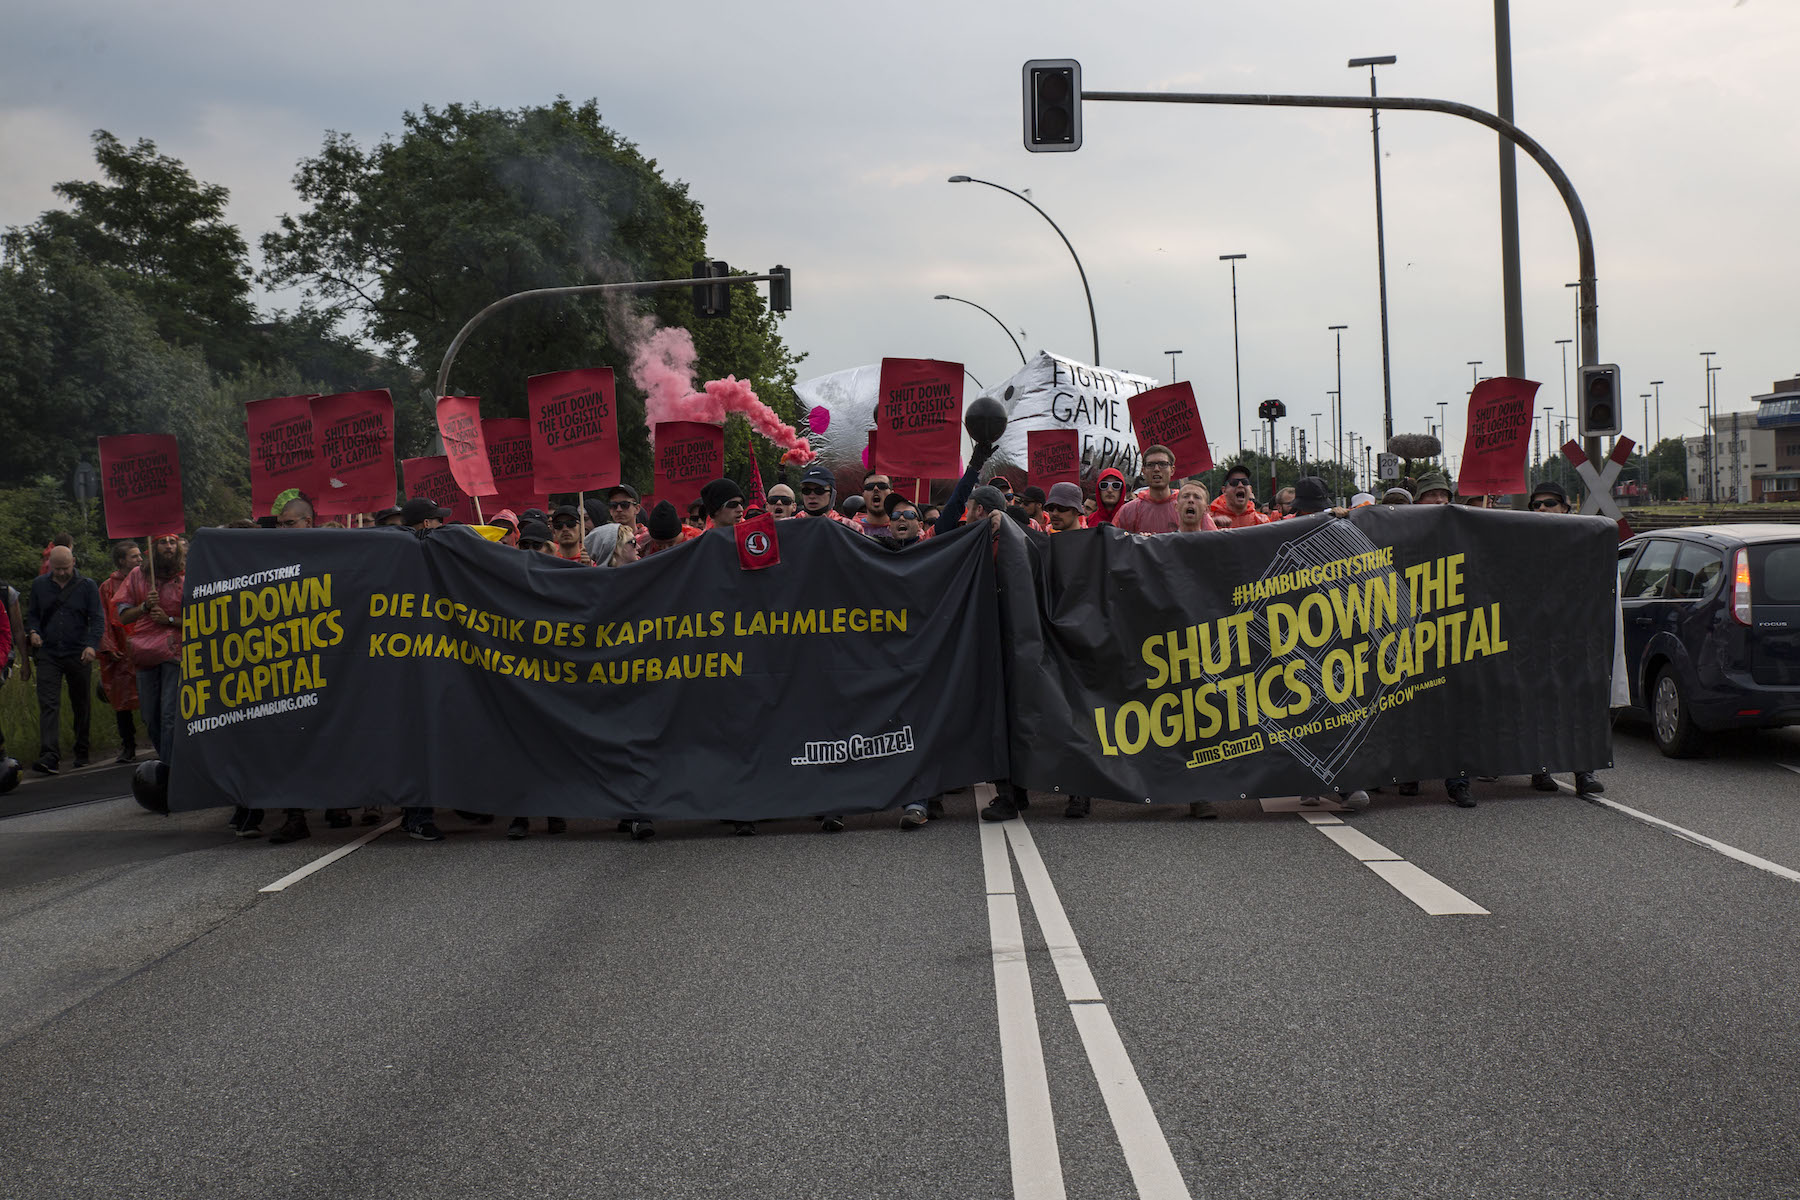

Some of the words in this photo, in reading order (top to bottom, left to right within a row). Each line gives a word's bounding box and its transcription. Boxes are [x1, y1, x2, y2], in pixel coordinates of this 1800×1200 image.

[1053, 360, 1118, 394] FIGHT
[541, 401, 566, 419] SHUT
[571, 391, 603, 411] DOWN
[889, 388, 915, 403] SHUT
[919, 384, 951, 399] DOWN
[885, 404, 902, 416] THE
[906, 397, 955, 414] LOGISTICS
[1053, 393, 1120, 432] GAME
[1141, 411, 1160, 429] SHUT
[1162, 399, 1187, 418] DOWN
[1476, 406, 1496, 422] SHUT
[1499, 400, 1524, 417] DOWN
[325, 424, 349, 441] SHUT
[353, 414, 383, 434] DOWN
[538, 419, 556, 434] THE
[560, 404, 608, 428] LOGISTICS
[892, 416, 905, 430] OF
[909, 412, 946, 428] CAPITAL
[1141, 425, 1156, 440] THE
[1157, 408, 1193, 433] LOGISTICS
[1472, 422, 1485, 437] THE
[1488, 413, 1526, 433] LOGISTICS
[260, 428, 283, 445] SHUT
[322, 441, 339, 457] THE
[343, 426, 387, 451] LOGISTICS
[547, 432, 559, 445] OF
[564, 421, 603, 441] CAPITAL
[1162, 421, 1192, 442] CAPITAL
[1475, 435, 1486, 449] OF
[1488, 428, 1518, 446] CAPITAL
[257, 445, 272, 459] THE
[277, 434, 314, 454] LOGISTIC
[331, 455, 342, 468] OF
[347, 444, 382, 464] CAPITAL
[489, 443, 509, 455] SHUT
[513, 440, 532, 452] DOW
[503, 451, 533, 465] LOGISTI
[664, 445, 684, 457] SHUT
[688, 440, 713, 453] DOWN
[1034, 448, 1049, 459] SHUT
[1052, 444, 1071, 455] DOWN
[112, 460, 135, 475] SHUT
[138, 454, 167, 469] DOWN
[265, 459, 276, 471] OF
[280, 449, 314, 467] CAPITAL
[492, 466, 502, 477] OF
[505, 462, 533, 475] CAPITA
[661, 458, 674, 470] THE
[678, 451, 717, 466] LOGISTICS
[667, 468, 676, 479] OF
[680, 463, 711, 476] CAPITAL
[1032, 458, 1042, 468] THE
[1045, 451, 1074, 465] LOGISTICS
[1037, 467, 1044, 475] OF
[1047, 461, 1070, 472] CAPITAL
[1382, 459, 1397, 467] 209
[109, 474, 126, 488] THE
[128, 464, 173, 484] LOGISTICS
[414, 479, 431, 493] SHUT
[434, 473, 452, 486] DOW
[1388, 468, 1393, 476] 0
[118, 487, 128, 498] OF
[132, 479, 168, 494] CAPITAL
[427, 483, 459, 499] LOGISTIC
[436, 493, 459, 507] PITAL
[193, 564, 300, 599] #HAMBURGCITYSTRIKE
[1233, 546, 1393, 606] #HAMBURGCITYSTRIKE
[182, 595, 232, 642] HUT
[240, 574, 331, 627] DOWN
[369, 593, 414, 618] DIE
[420, 593, 525, 642] LOGISTIK
[533, 620, 586, 647] DES
[595, 611, 725, 648] KAPITALS
[734, 608, 907, 636] LAHMLEGEN
[1142, 610, 1254, 689] SHUT
[1266, 572, 1397, 658] DOWN
[1405, 553, 1465, 617] THE
[210, 609, 344, 673] LOGISTICS
[369, 633, 578, 683] KOMMUNISMUS
[587, 652, 742, 684] AUFBAUEN
[180, 680, 211, 720] OF
[219, 654, 327, 708] CAPITAL
[1095, 659, 1312, 756] LOGISTICS
[1322, 641, 1369, 704] OF
[1377, 602, 1508, 685] CAPITAL
[187, 693, 318, 736] SHUTDOWN-HAMBURG.ORG
[1268, 722, 1322, 744] BEYOND
[1326, 706, 1368, 730] EUROPE
[1379, 685, 1414, 711] GROW
[1414, 677, 1446, 692] HAMBURG
[849, 726, 914, 760] Ganze!
[1221, 733, 1263, 758] Ganze!
